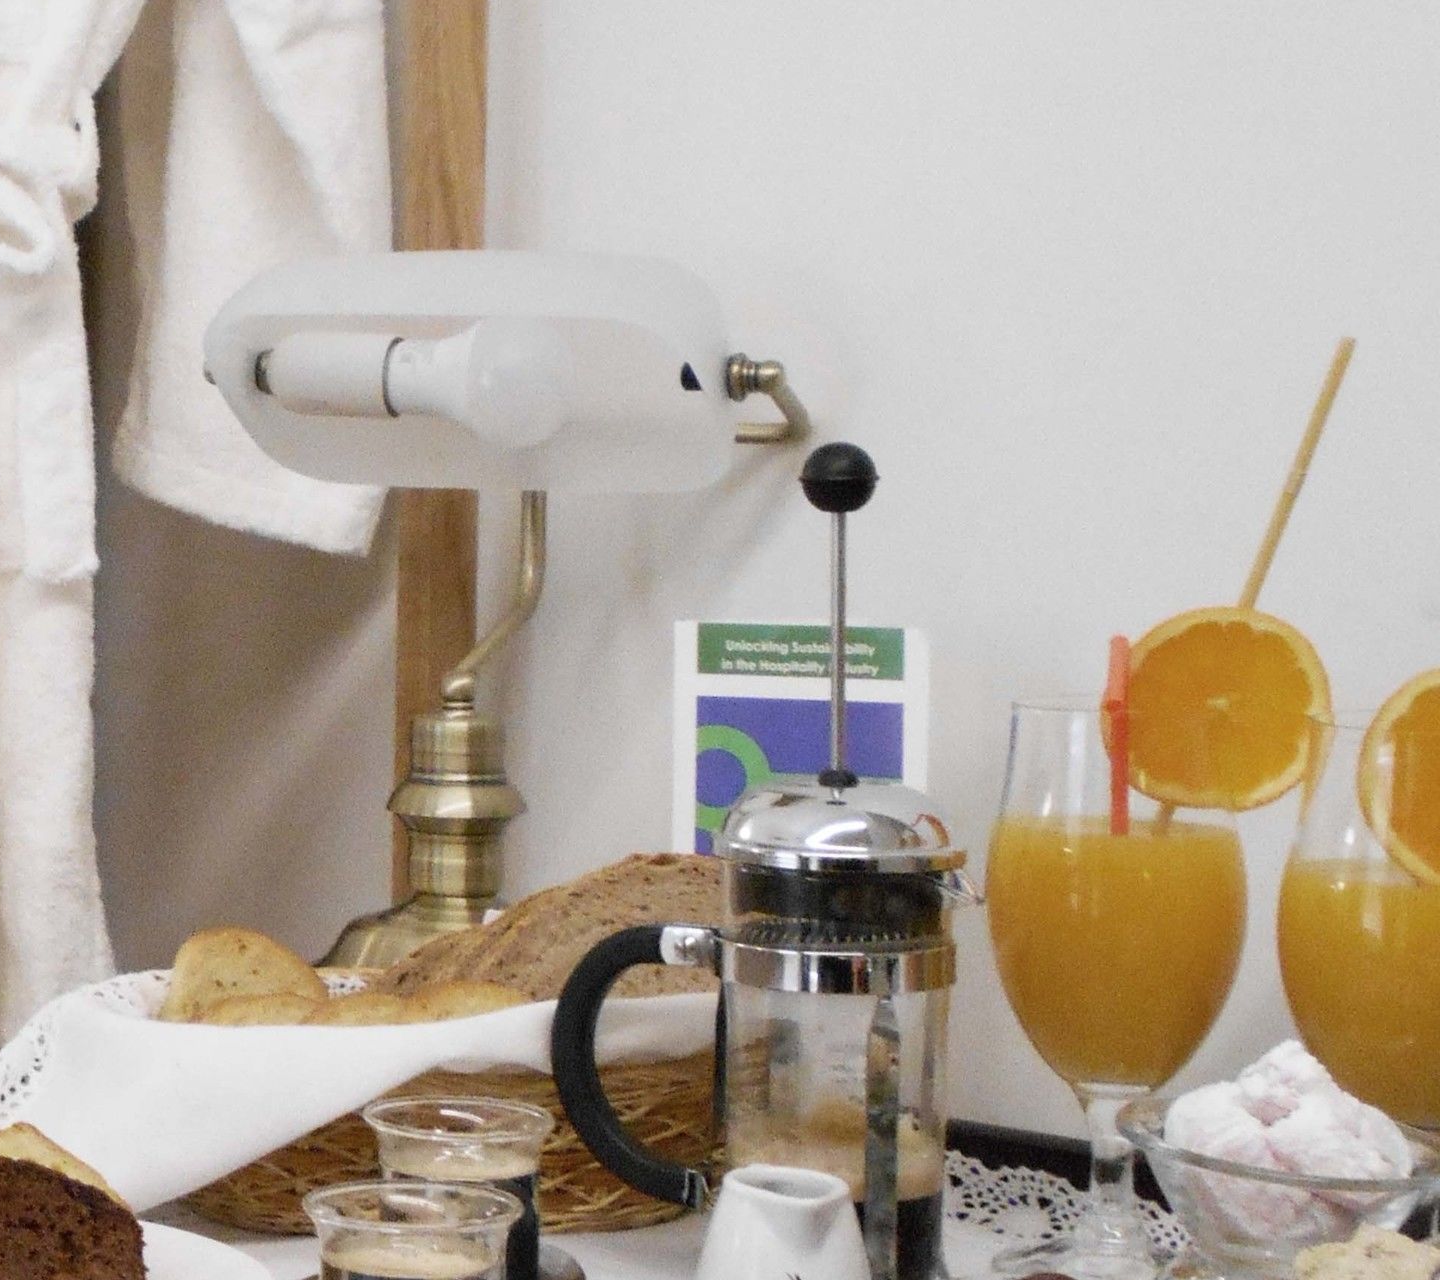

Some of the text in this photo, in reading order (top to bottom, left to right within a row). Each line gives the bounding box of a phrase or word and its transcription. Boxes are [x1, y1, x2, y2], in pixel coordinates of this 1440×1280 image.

[725, 639, 789, 655] Unlocking
[721, 658, 733, 670] in
[736, 658, 757, 671] the
[758, 659, 825, 675] Hospitality
